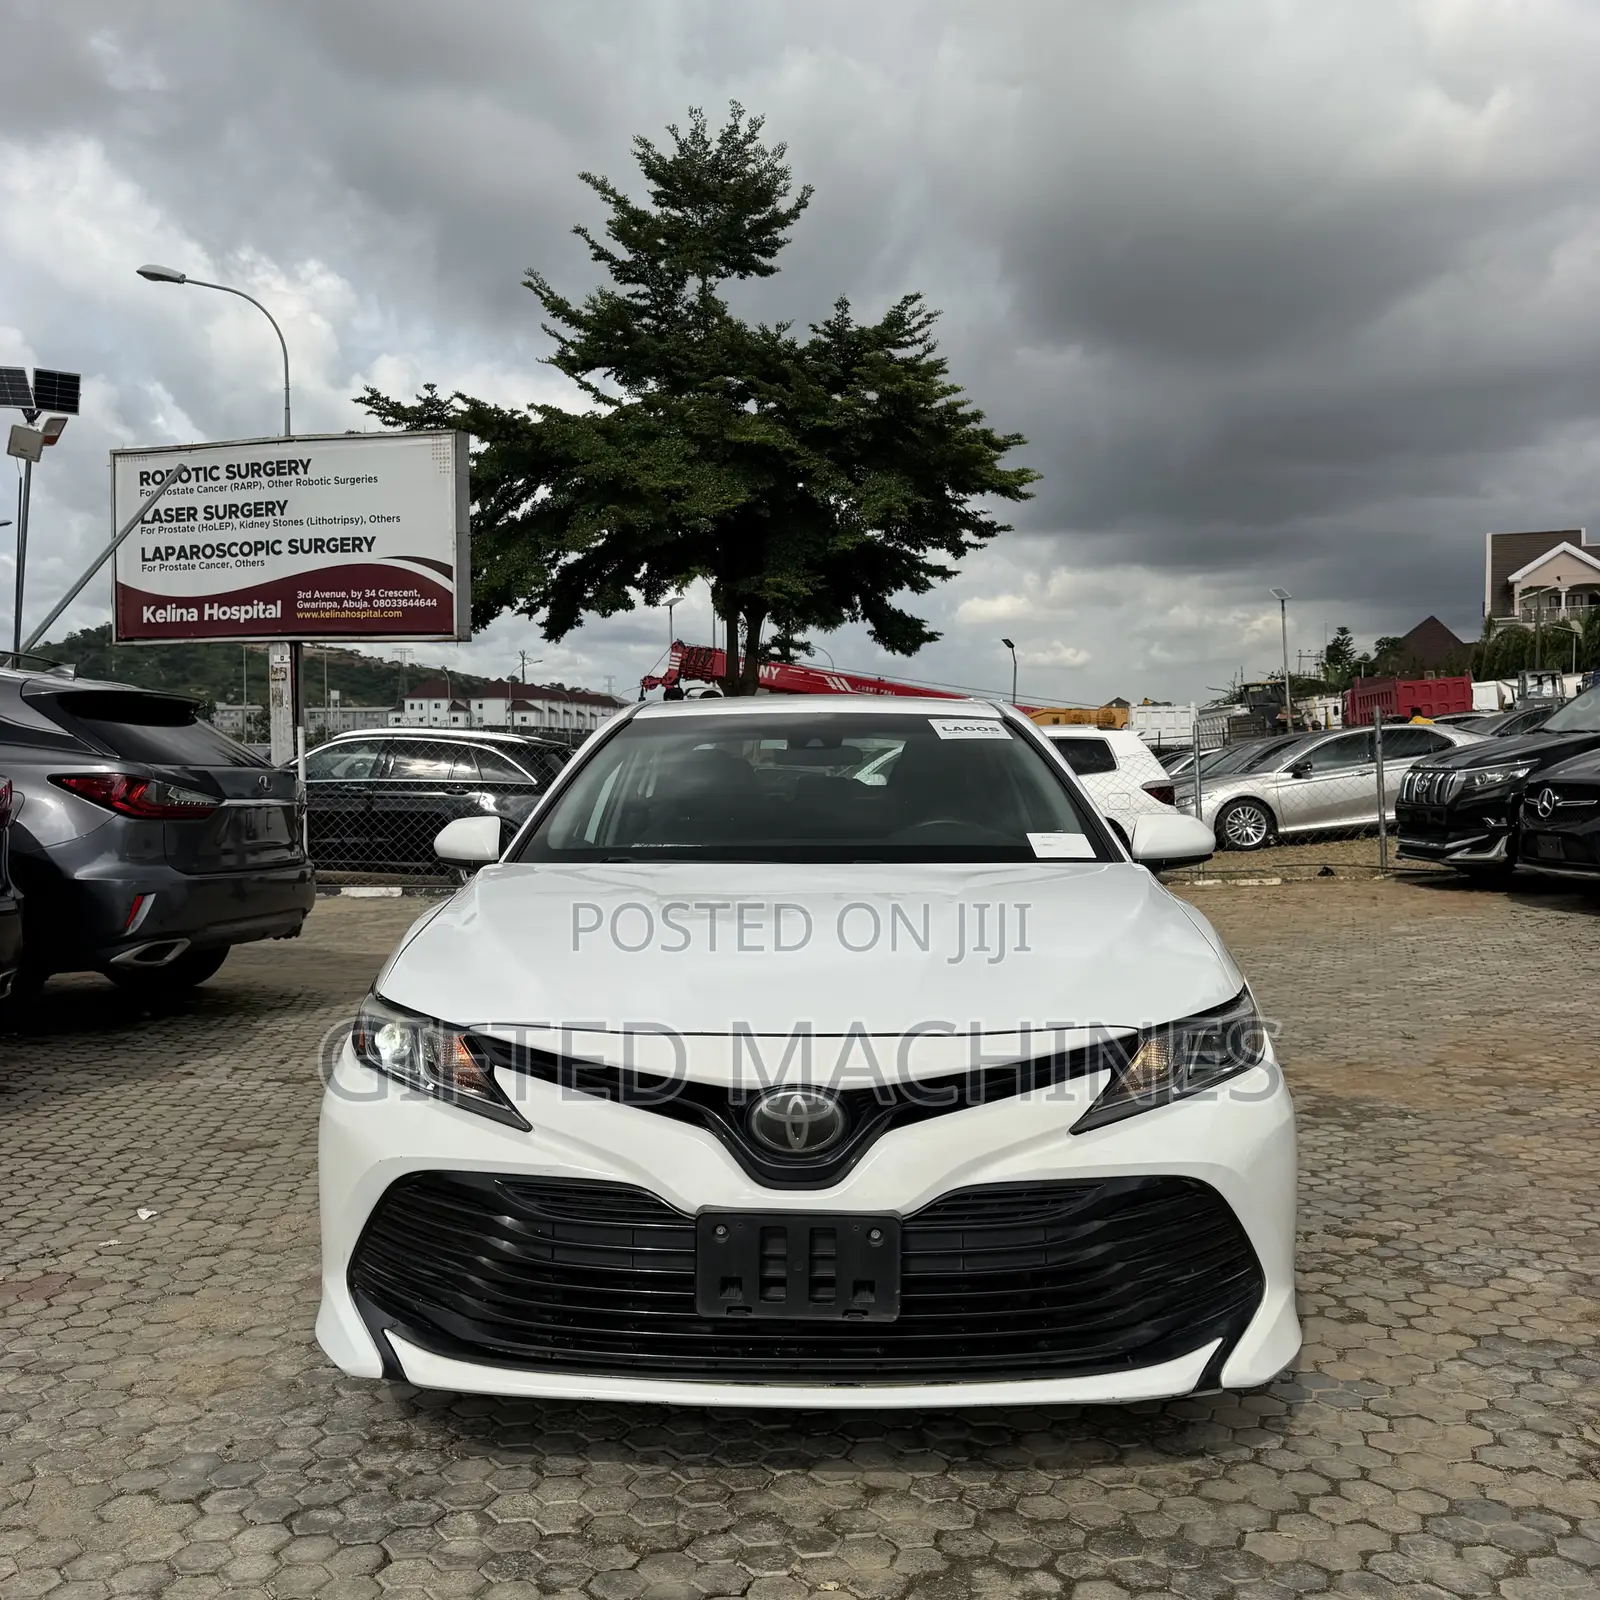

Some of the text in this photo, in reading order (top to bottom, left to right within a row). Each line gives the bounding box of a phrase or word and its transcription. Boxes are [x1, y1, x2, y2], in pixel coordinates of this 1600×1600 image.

[225, 459, 311, 480] SURGERY
[160, 486, 194, 496] rostate
[197, 485, 227, 494] Cancer
[230, 481, 265, 492] (RARP),
[267, 479, 293, 488] Other
[296, 476, 331, 487] Robotic
[334, 474, 378, 485] Surgeries
[203, 500, 288, 520] SURGERY
[141, 514, 400, 534] For Prostate (HoLEP), Kidney Stones (Lithotripsy), Others
[141, 536, 376, 562] LAPAROSCOPIC SURGERY
[141, 559, 265, 572] For Prostate Cancer, Others
[297, 589, 420, 600] 3rd Avenue, by 34 Crescent,
[297, 599, 437, 610] Gwarinpa, Abuja. 08033644644
[142, 599, 281, 623] Kelina Hospital
[297, 609, 402, 619] www.kelinahospital.com
